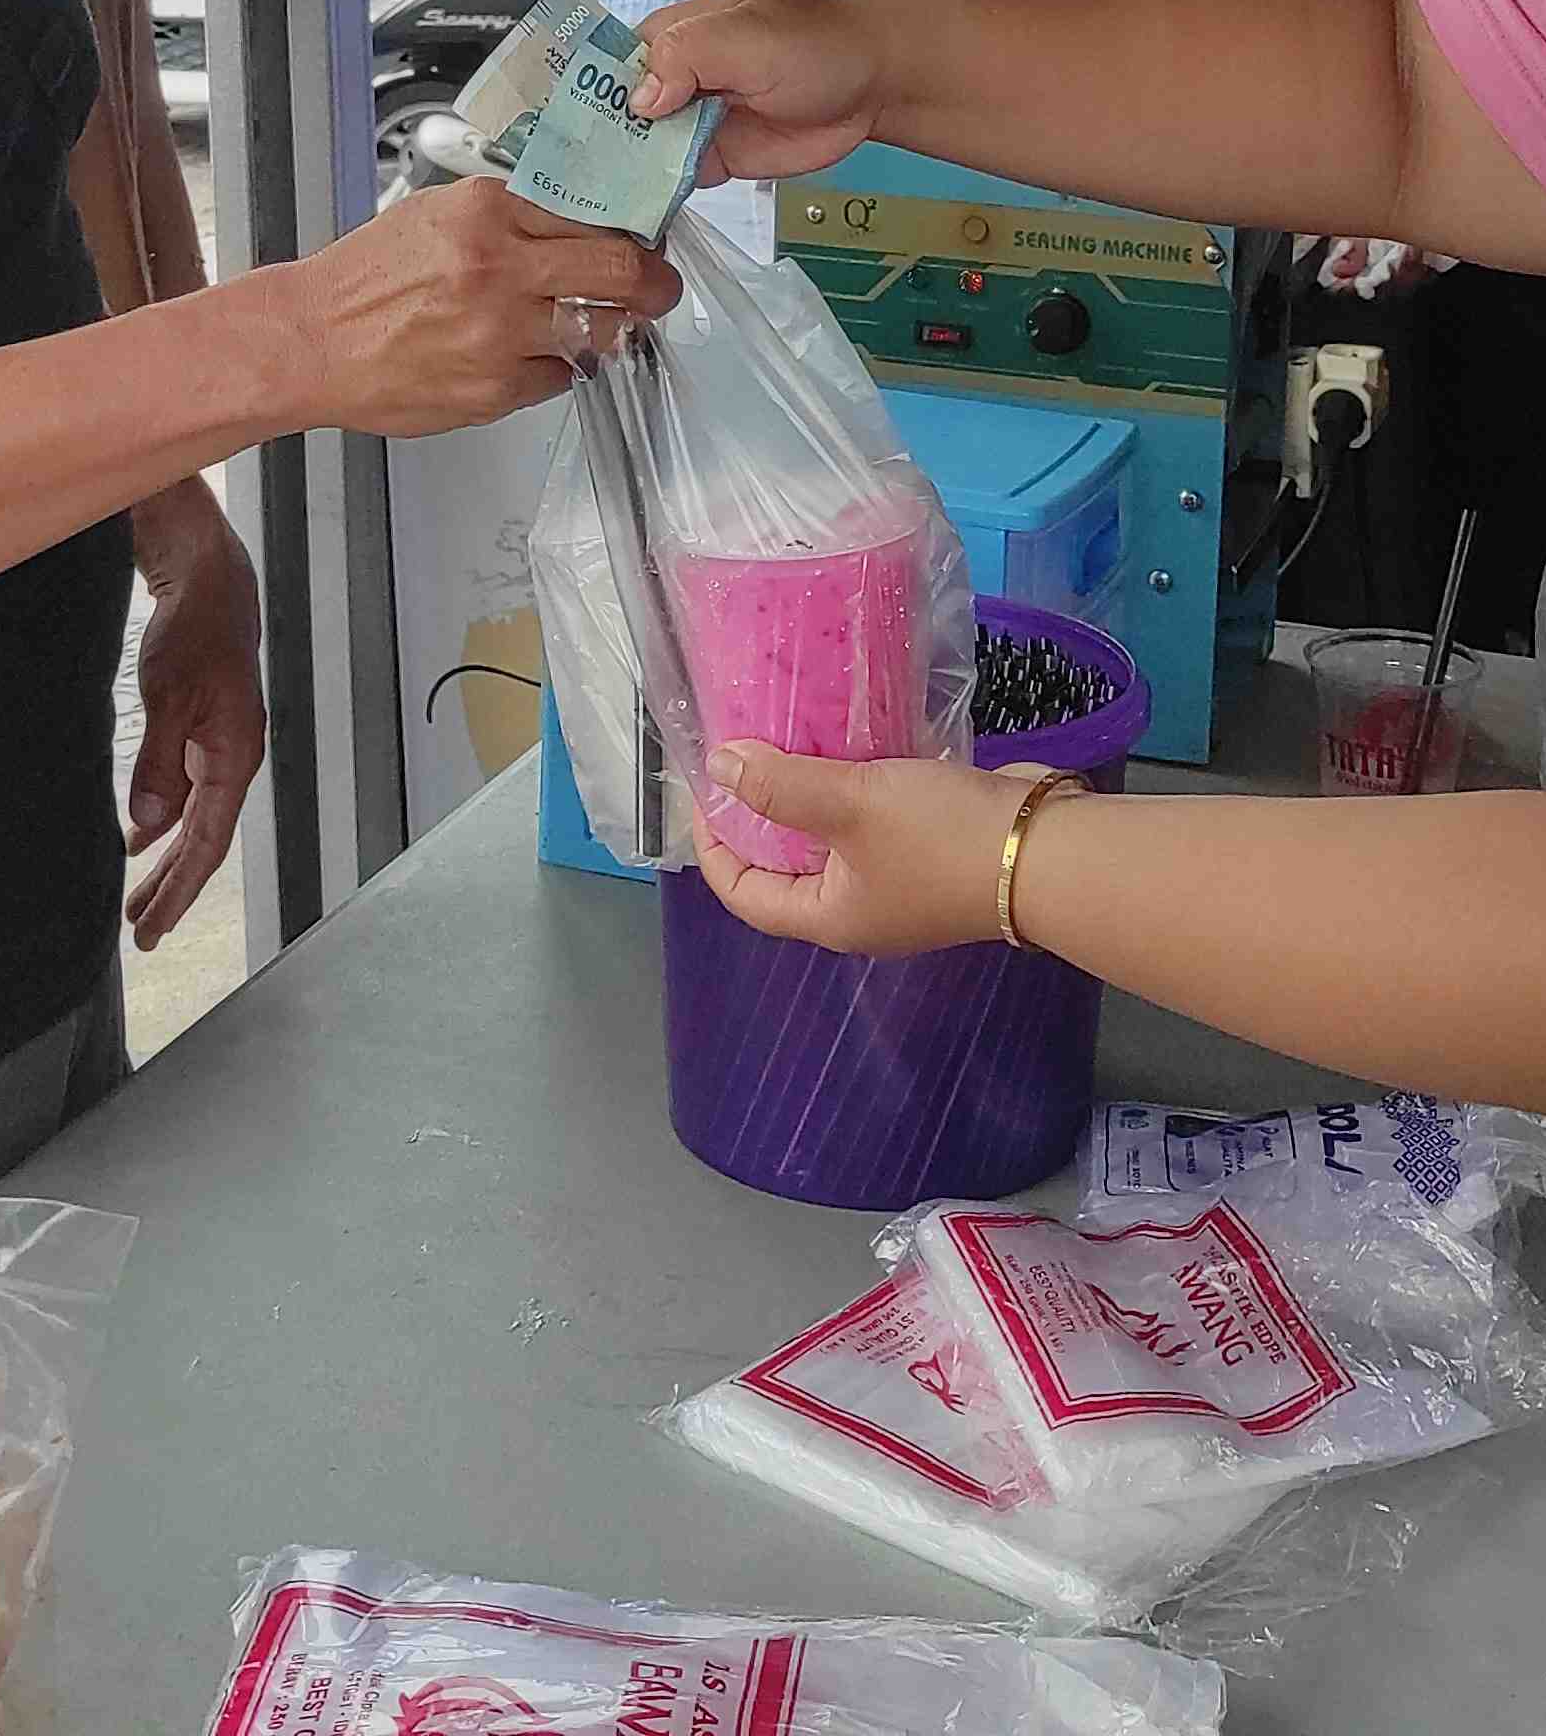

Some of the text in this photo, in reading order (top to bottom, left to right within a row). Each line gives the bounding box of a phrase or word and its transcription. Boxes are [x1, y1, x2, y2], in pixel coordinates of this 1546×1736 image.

[553, 4, 590, 43] 50000
[569, 86, 621, 125] INDONESIA
[1013, 229, 1194, 265] SEALING MACHINE
[298, 1677, 333, 1723] BEST
